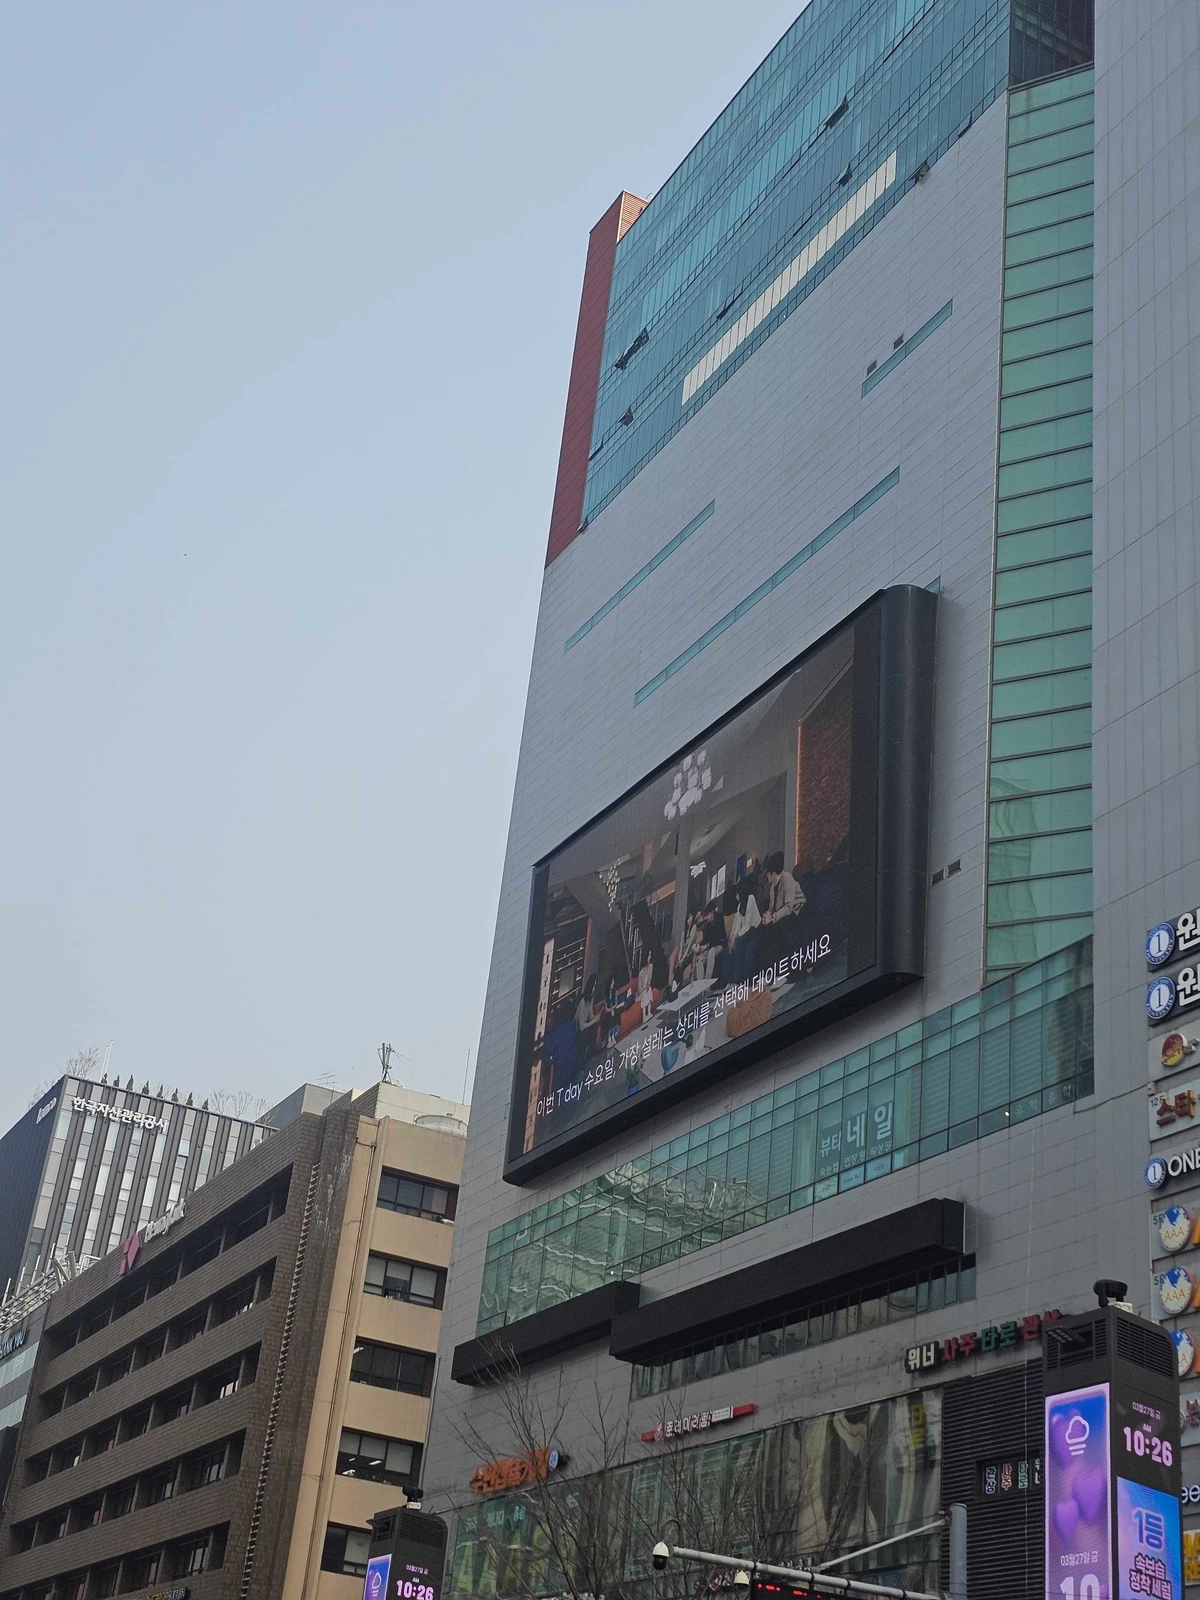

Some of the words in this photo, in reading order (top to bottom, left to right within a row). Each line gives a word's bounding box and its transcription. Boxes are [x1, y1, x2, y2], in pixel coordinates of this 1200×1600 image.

[537, 1091, 554, 1117] 이번
[557, 1088, 564, 1106] T
[564, 1081, 583, 1102] day
[584, 1057, 616, 1091] 수요일,
[619, 1041, 639, 1069] 가장
[641, 1026, 674, 1060] 설레는
[676, 1001, 711, 1039] 상대를
[713, 978, 749, 1018] 선택해
[73, 1096, 169, 1132] 한국자산관리공사
[1156, 1089, 1197, 1128] 스타
[820, 1131, 841, 1158] 뷰티
[1164, 1226, 1184, 1242] AAA
[1165, 1288, 1186, 1304] AAA
[907, 1342, 935, 1371] 위너
[942, 1331, 977, 1362] 사주
[981, 1320, 1018, 1352] 타로
[1132, 1402, 1154, 1418] 03월27일
[1143, 1423, 1152, 1433] AM
[1123, 1426, 1173, 1467] 10:26
[1133, 1508, 1164, 1551] 1등
[1060, 1552, 1090, 1567] 03월27일
[1091, 1551, 1098, 1564] 금
[1135, 1553, 1165, 1580] 속보습
[397, 1579, 434, 1600] 10:26
